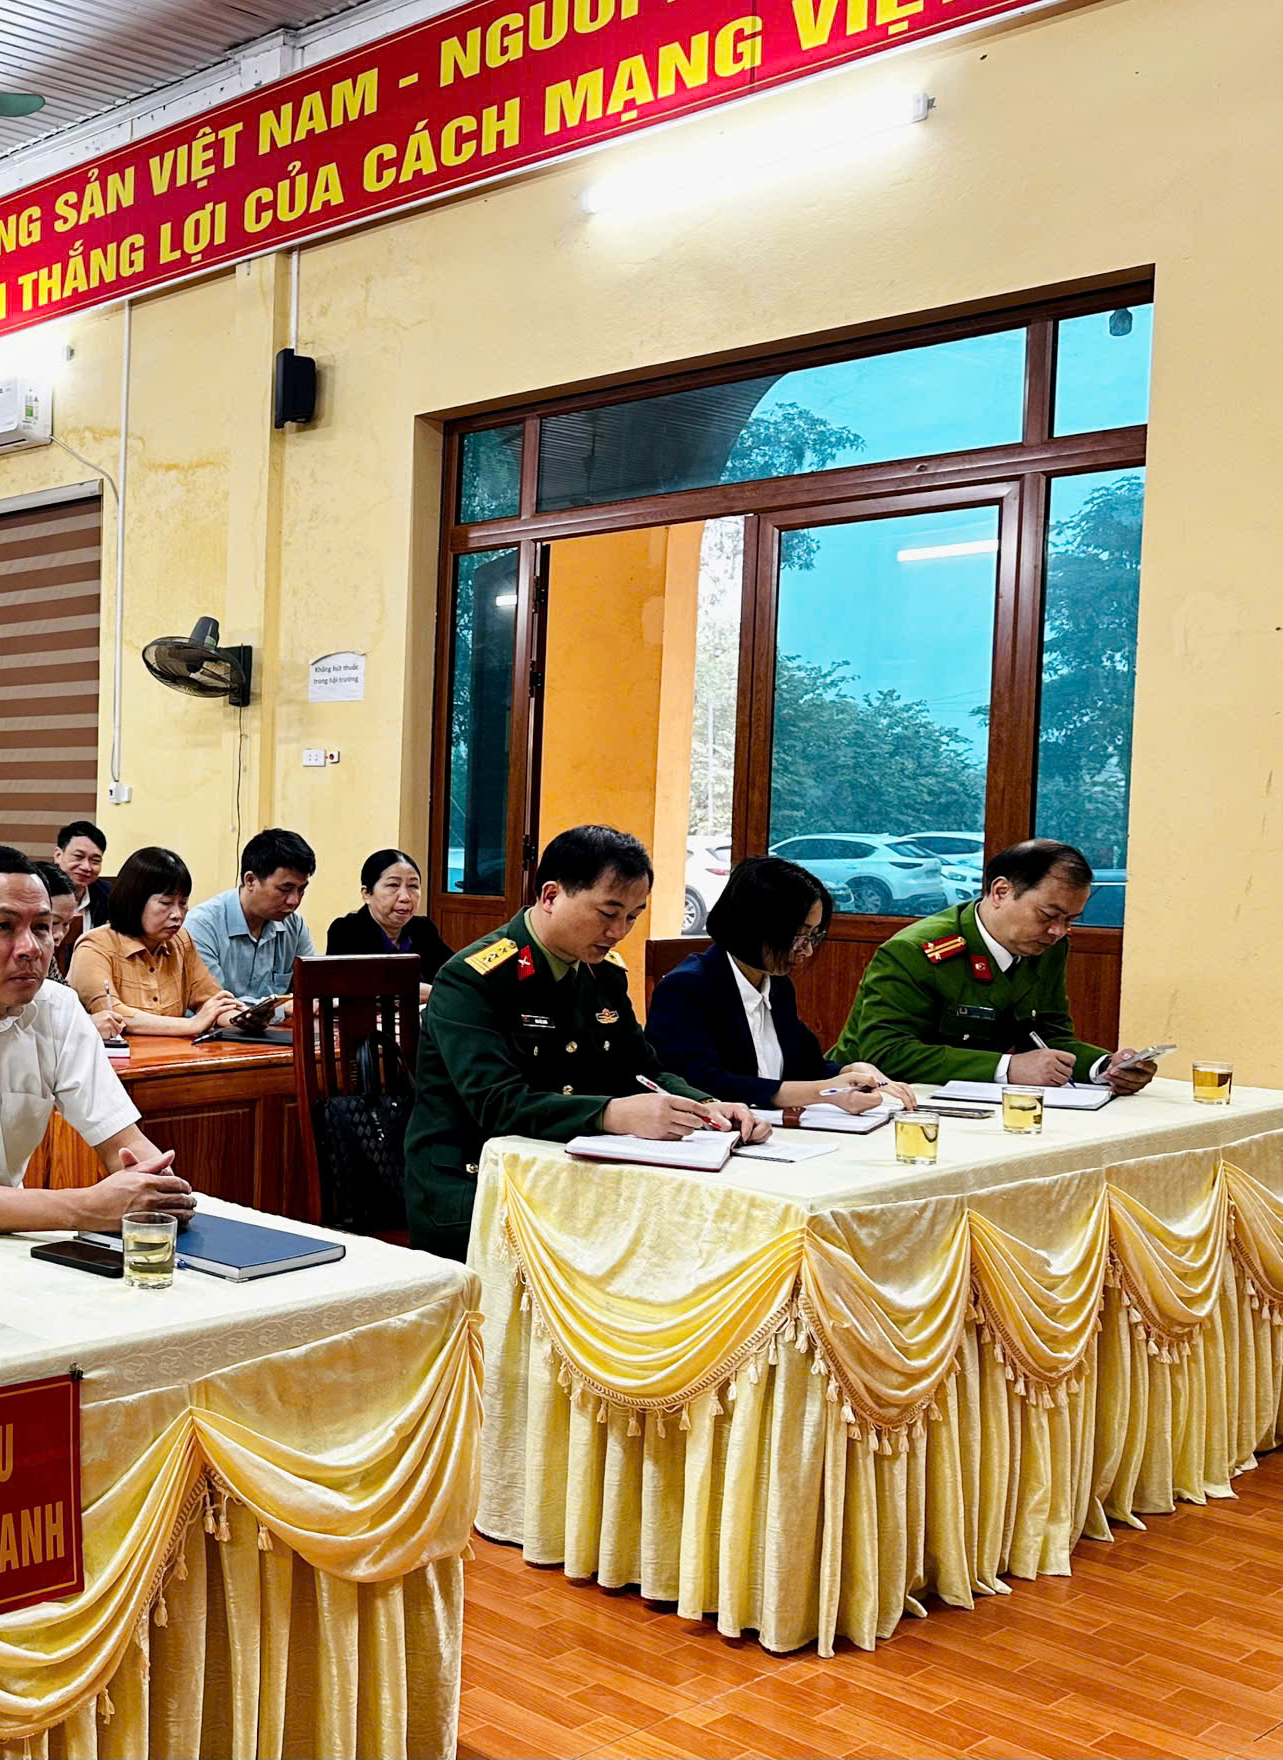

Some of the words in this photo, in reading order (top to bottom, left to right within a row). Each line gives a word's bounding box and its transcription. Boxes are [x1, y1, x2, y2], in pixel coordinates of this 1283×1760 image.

[19, 235, 145, 311] THẮNG
[160, 202, 227, 264] LỢI
[245, 161, 344, 233] CỦA
[363, 98, 521, 193] CÁCH
[545, 16, 763, 136] MẠNG
[55, 168, 135, 233] SẢN
[149, 122, 244, 196] VIỆT
[258, 69, 378, 155] NAM
